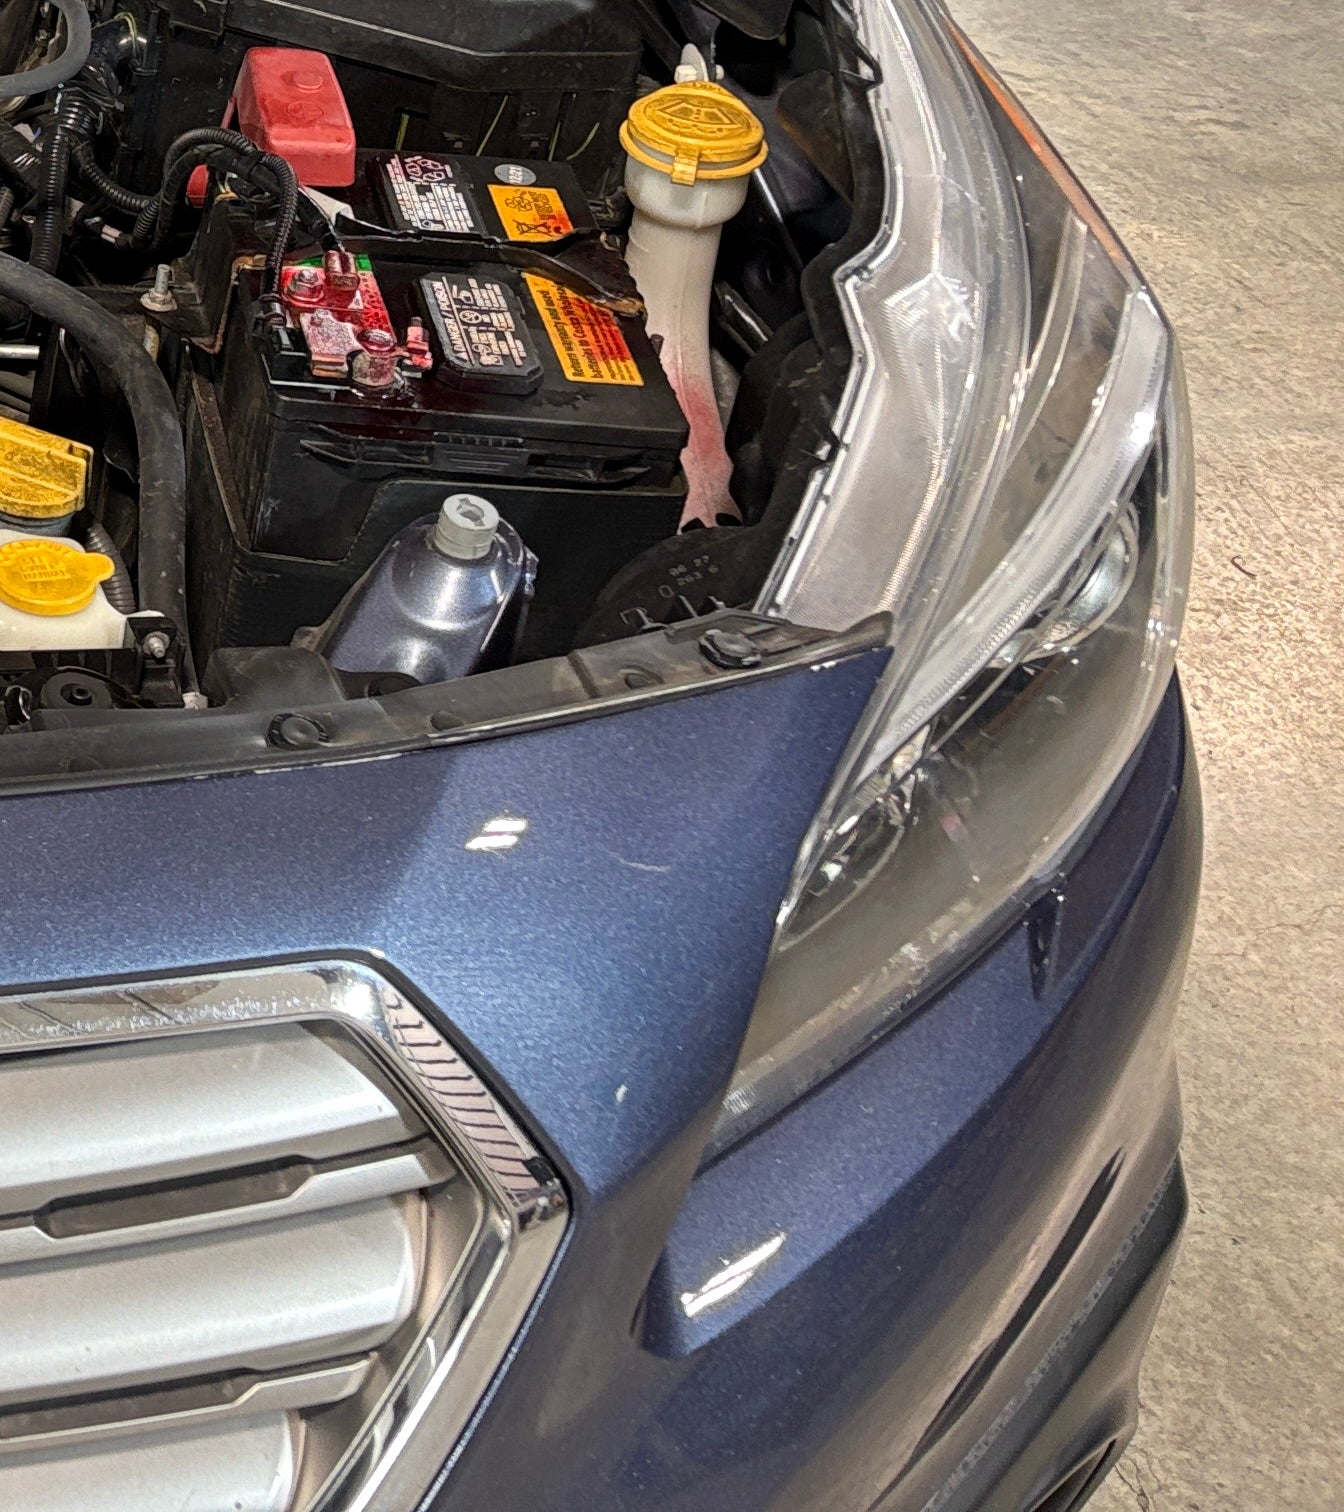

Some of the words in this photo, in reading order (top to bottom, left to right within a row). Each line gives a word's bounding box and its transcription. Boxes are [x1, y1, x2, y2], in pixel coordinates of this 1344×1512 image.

[433, 282, 453, 311] POISON
[444, 318, 466, 352] DANGER
[584, 348, 603, 378] batteries
